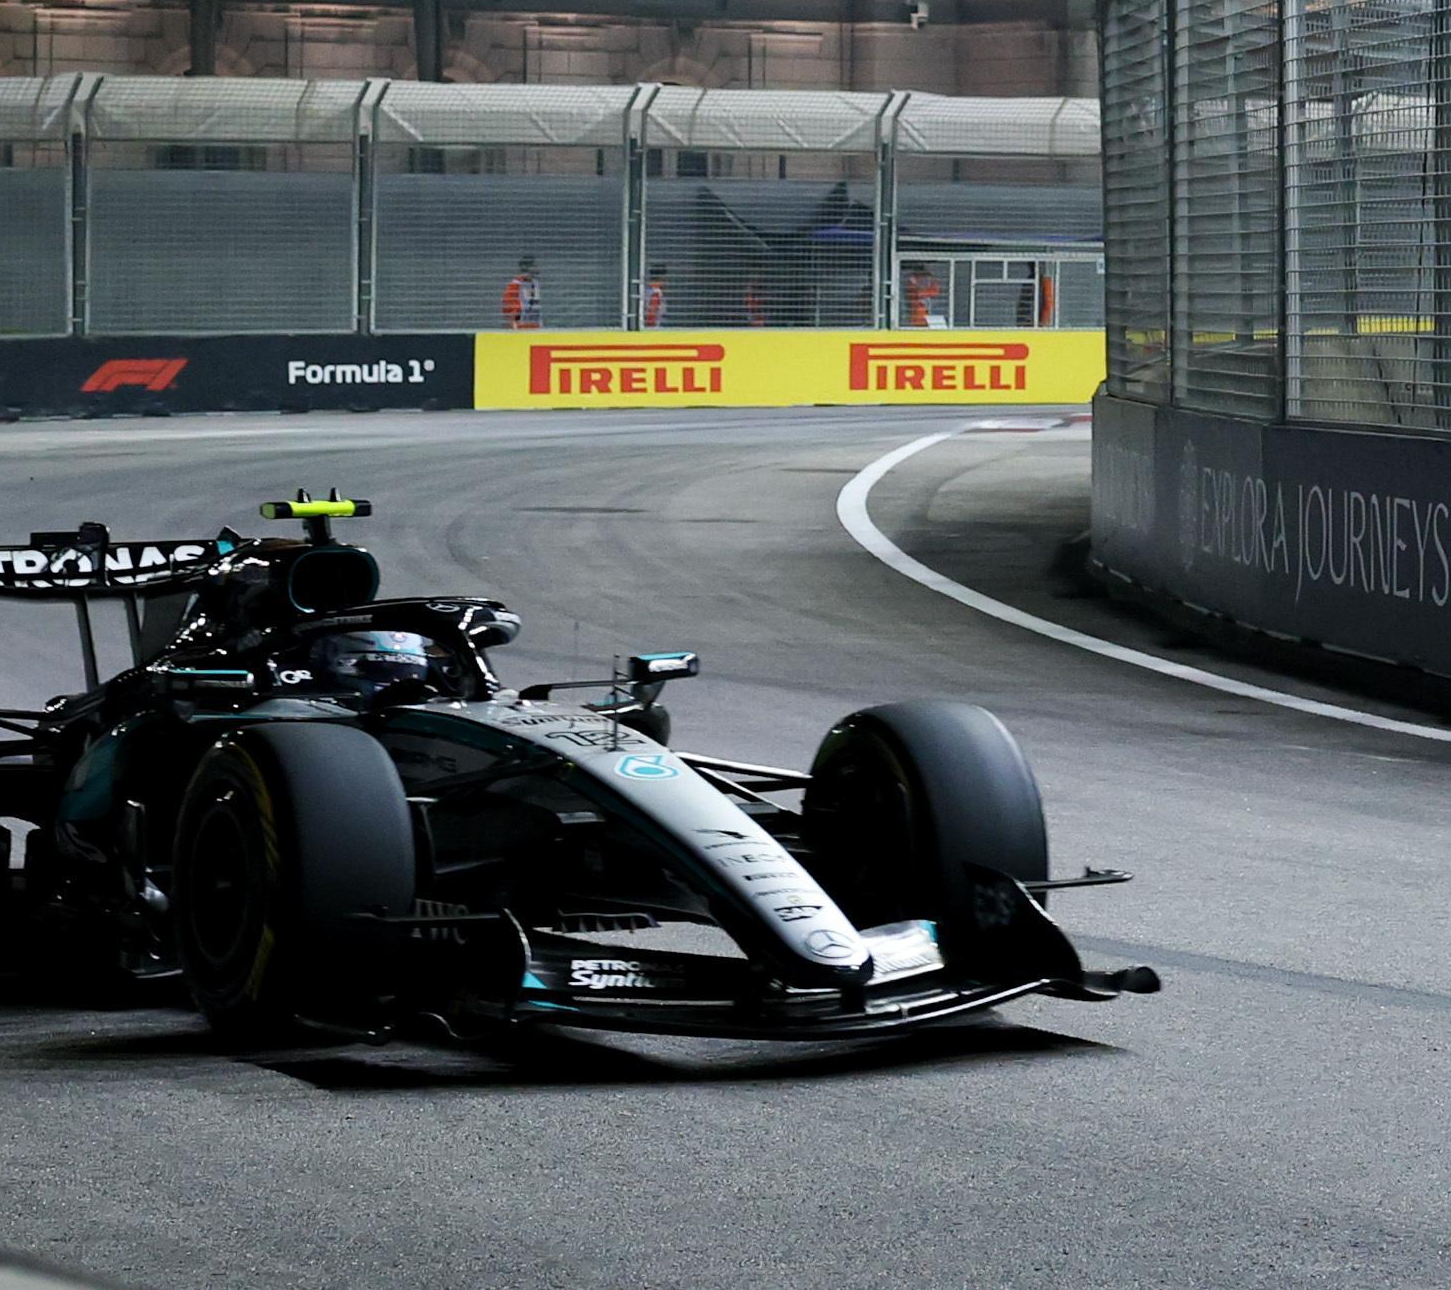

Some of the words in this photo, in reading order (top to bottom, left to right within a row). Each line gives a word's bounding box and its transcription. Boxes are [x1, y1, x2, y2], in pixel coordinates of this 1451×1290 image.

[288, 360, 403, 384] Formula
[529, 344, 725, 394] PIRELLI
[849, 342, 1030, 391] PIRELLI
[1201, 467, 1289, 574] EXPLORA
[1295, 485, 1450, 607] JOURNEYS
